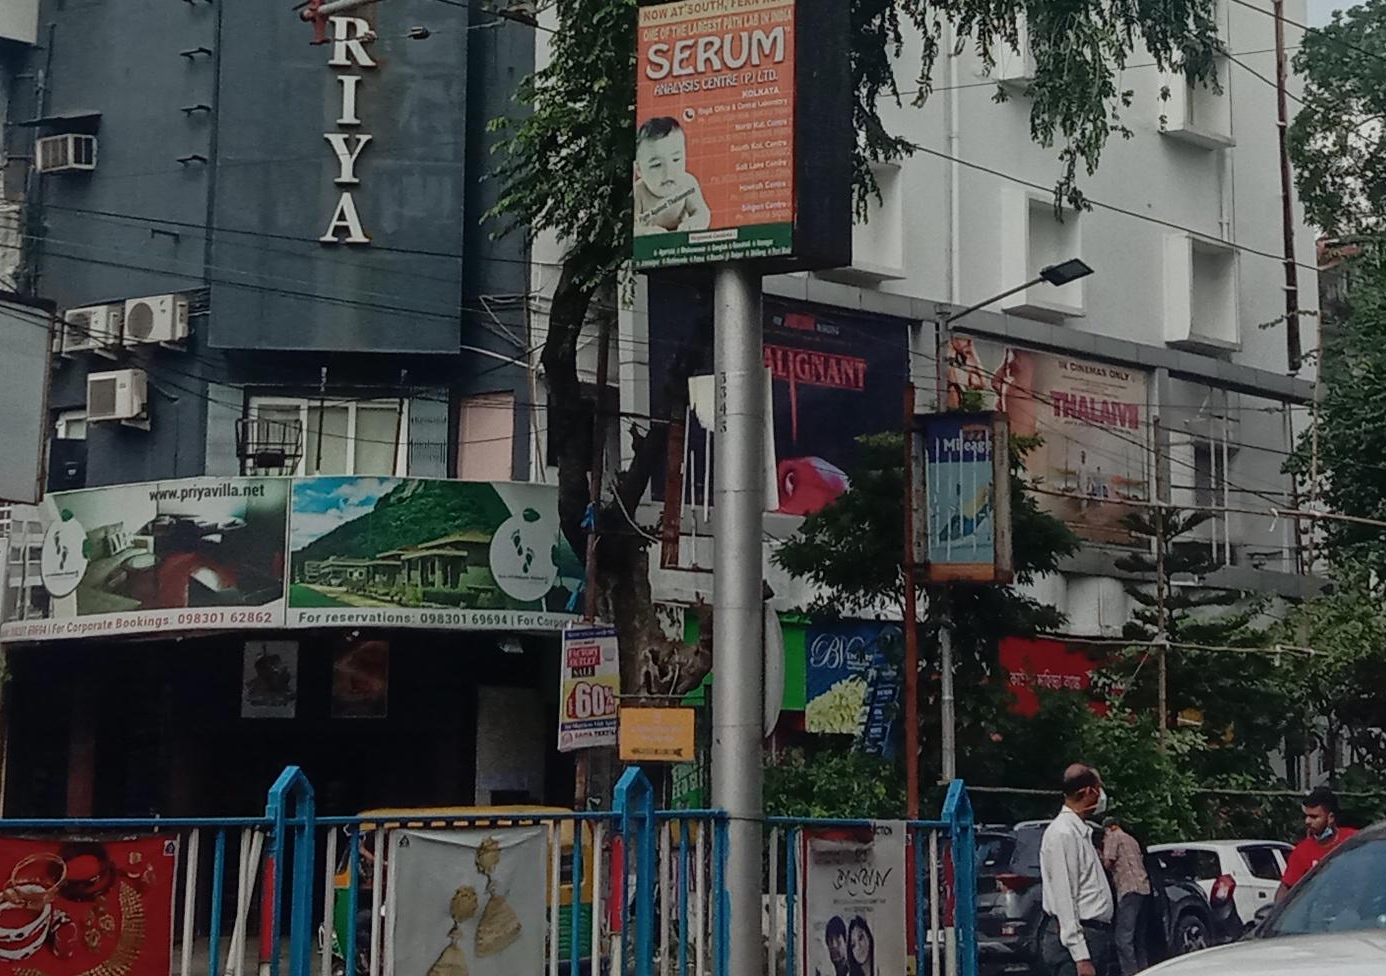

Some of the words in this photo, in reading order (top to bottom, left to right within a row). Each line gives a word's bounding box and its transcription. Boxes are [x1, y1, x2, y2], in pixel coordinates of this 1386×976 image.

[643, 8, 668, 21] NOW
[670, 5, 684, 18] AT
[646, 26, 785, 80] SERUM
[654, 79, 699, 96] ANALYSIS
[702, 74, 738, 90] CENTRE
[742, 87, 780, 98] KOLKATA
[763, 345, 867, 389] ALIGNANT
[1070, 362, 1107, 376] CINEMAS
[1109, 369, 1130, 381] ONLY
[149, 483, 265, 503] www.priyavilla.net
[67, 619, 113, 634] Corporate
[177, 612, 225, 625] 098301
[230, 611, 273, 624] 62862
[298, 611, 321, 624] For
[325, 611, 415, 624] reservations:
[420, 613, 467, 625] 098301
[471, 614, 507, 625] 69694
[517, 615, 534, 626] For
